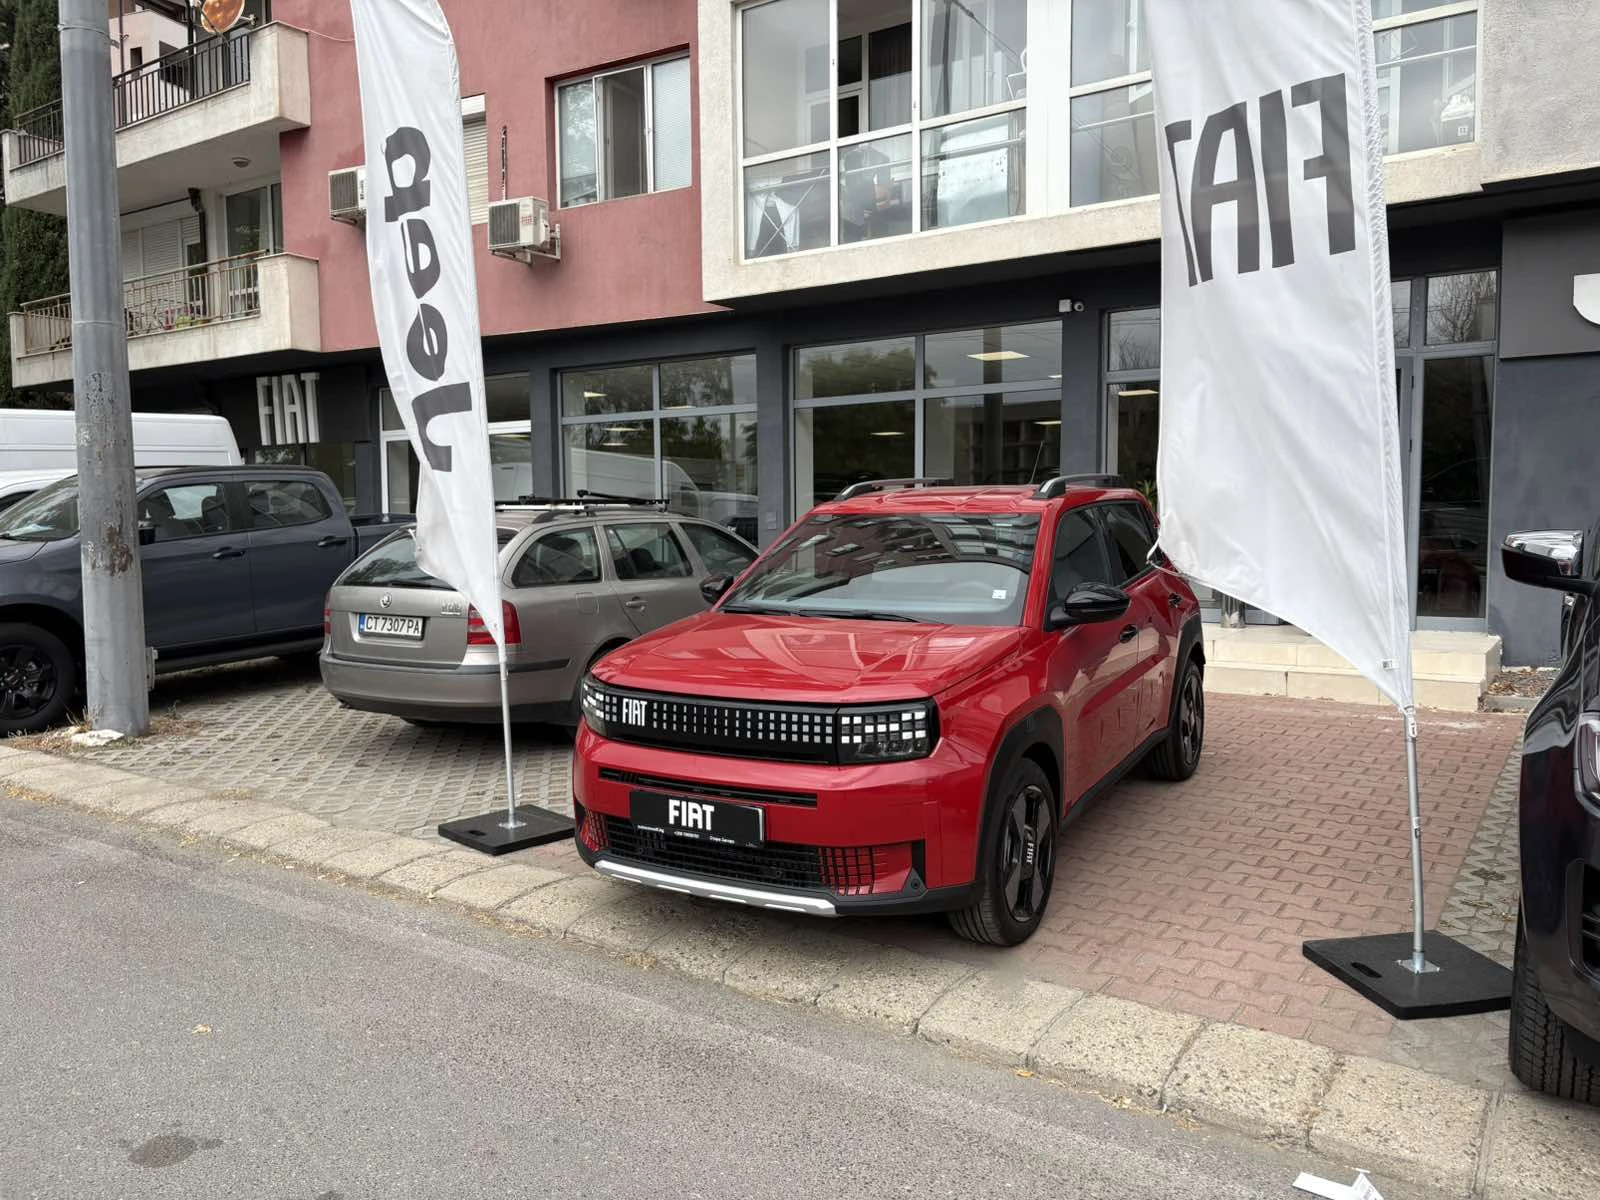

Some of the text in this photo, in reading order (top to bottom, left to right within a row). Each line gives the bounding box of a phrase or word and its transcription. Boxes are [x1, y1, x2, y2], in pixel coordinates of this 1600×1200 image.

[255, 372, 320, 446] FIAT
[622, 697, 648, 727] FIAT
[668, 798, 715, 831] FIAT
[1026, 842, 1034, 865] FIAT
